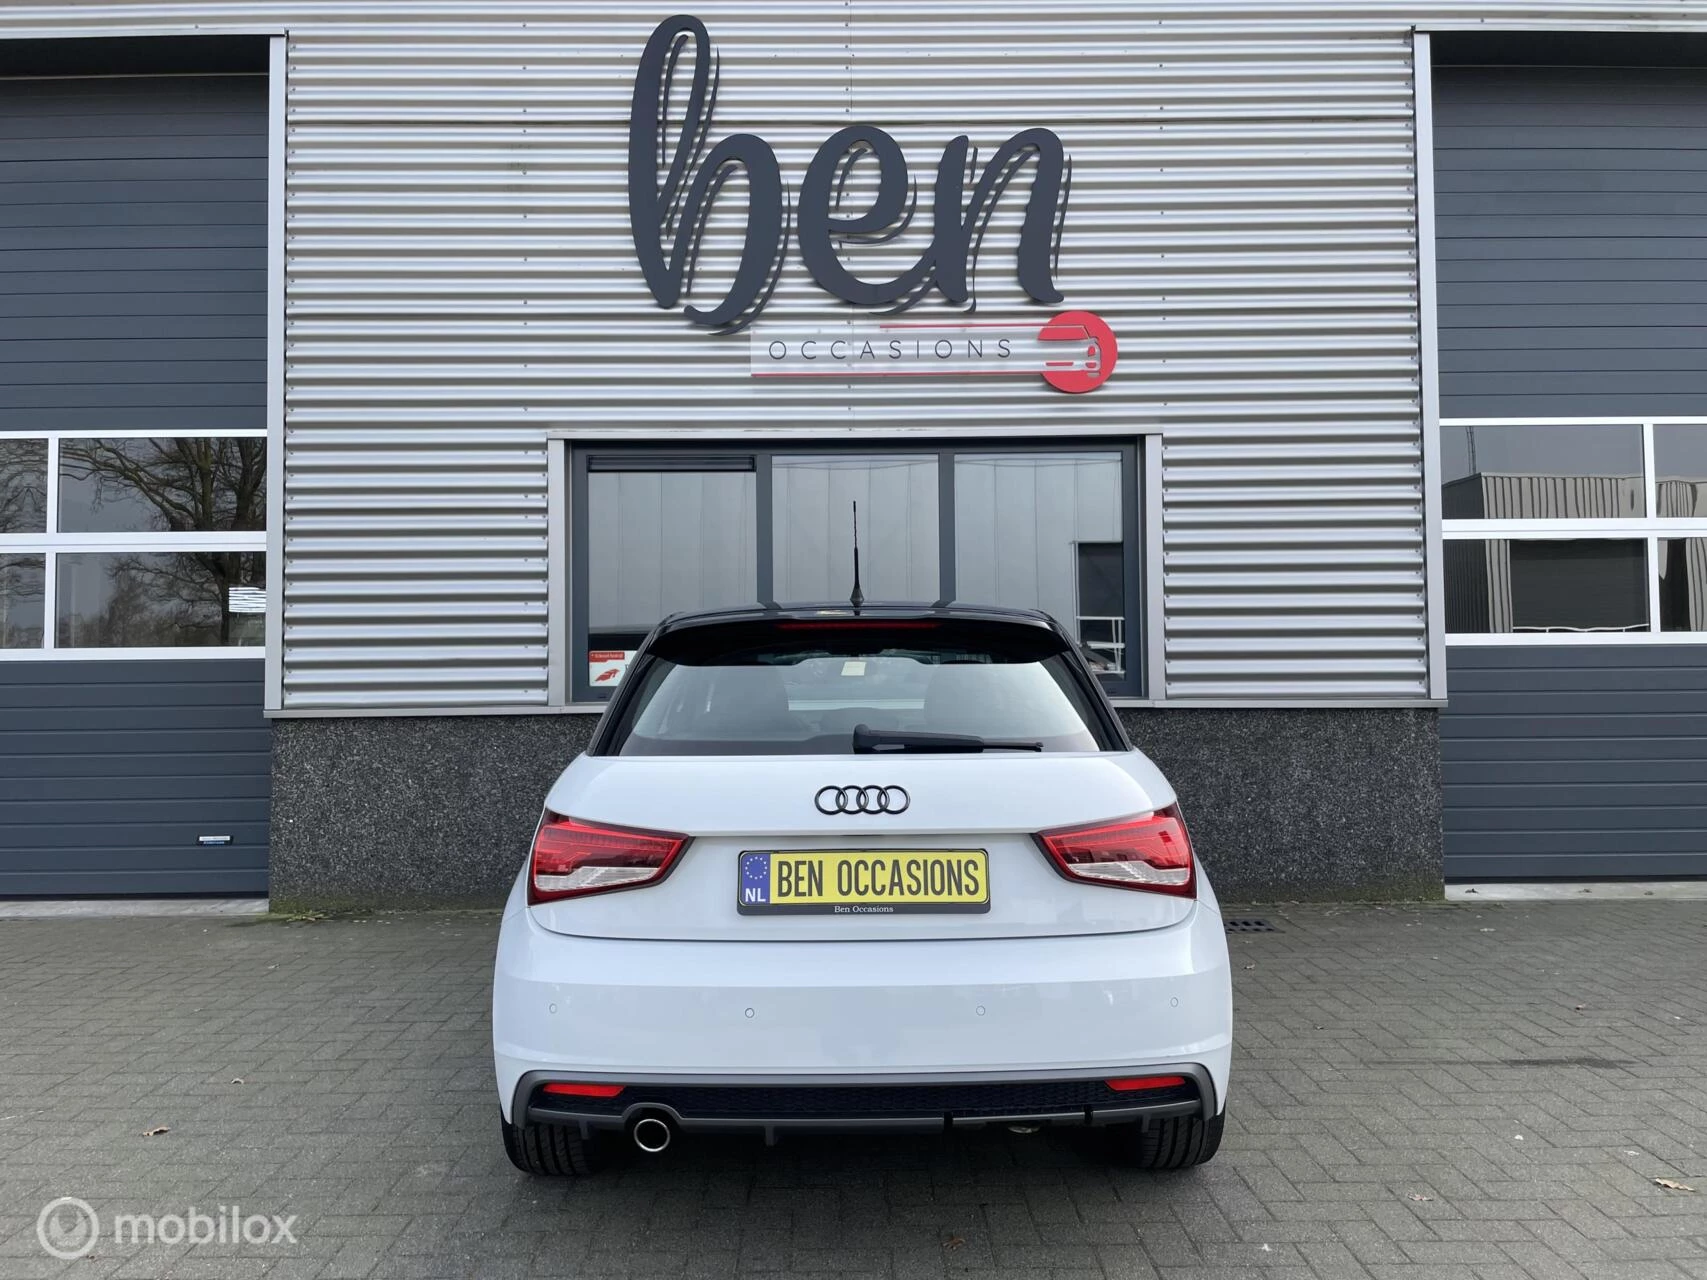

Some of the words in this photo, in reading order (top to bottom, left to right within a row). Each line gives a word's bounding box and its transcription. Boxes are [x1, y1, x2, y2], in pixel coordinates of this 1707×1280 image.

[628, 14, 1070, 333] ben
[768, 338, 1012, 360] OCCASIONS
[777, 860, 824, 897] BEN
[837, 859, 980, 897] OCCASIONS
[745, 888, 766, 902] NL
[834, 905, 850, 913] Ben
[852, 905, 894, 913] Occasions
